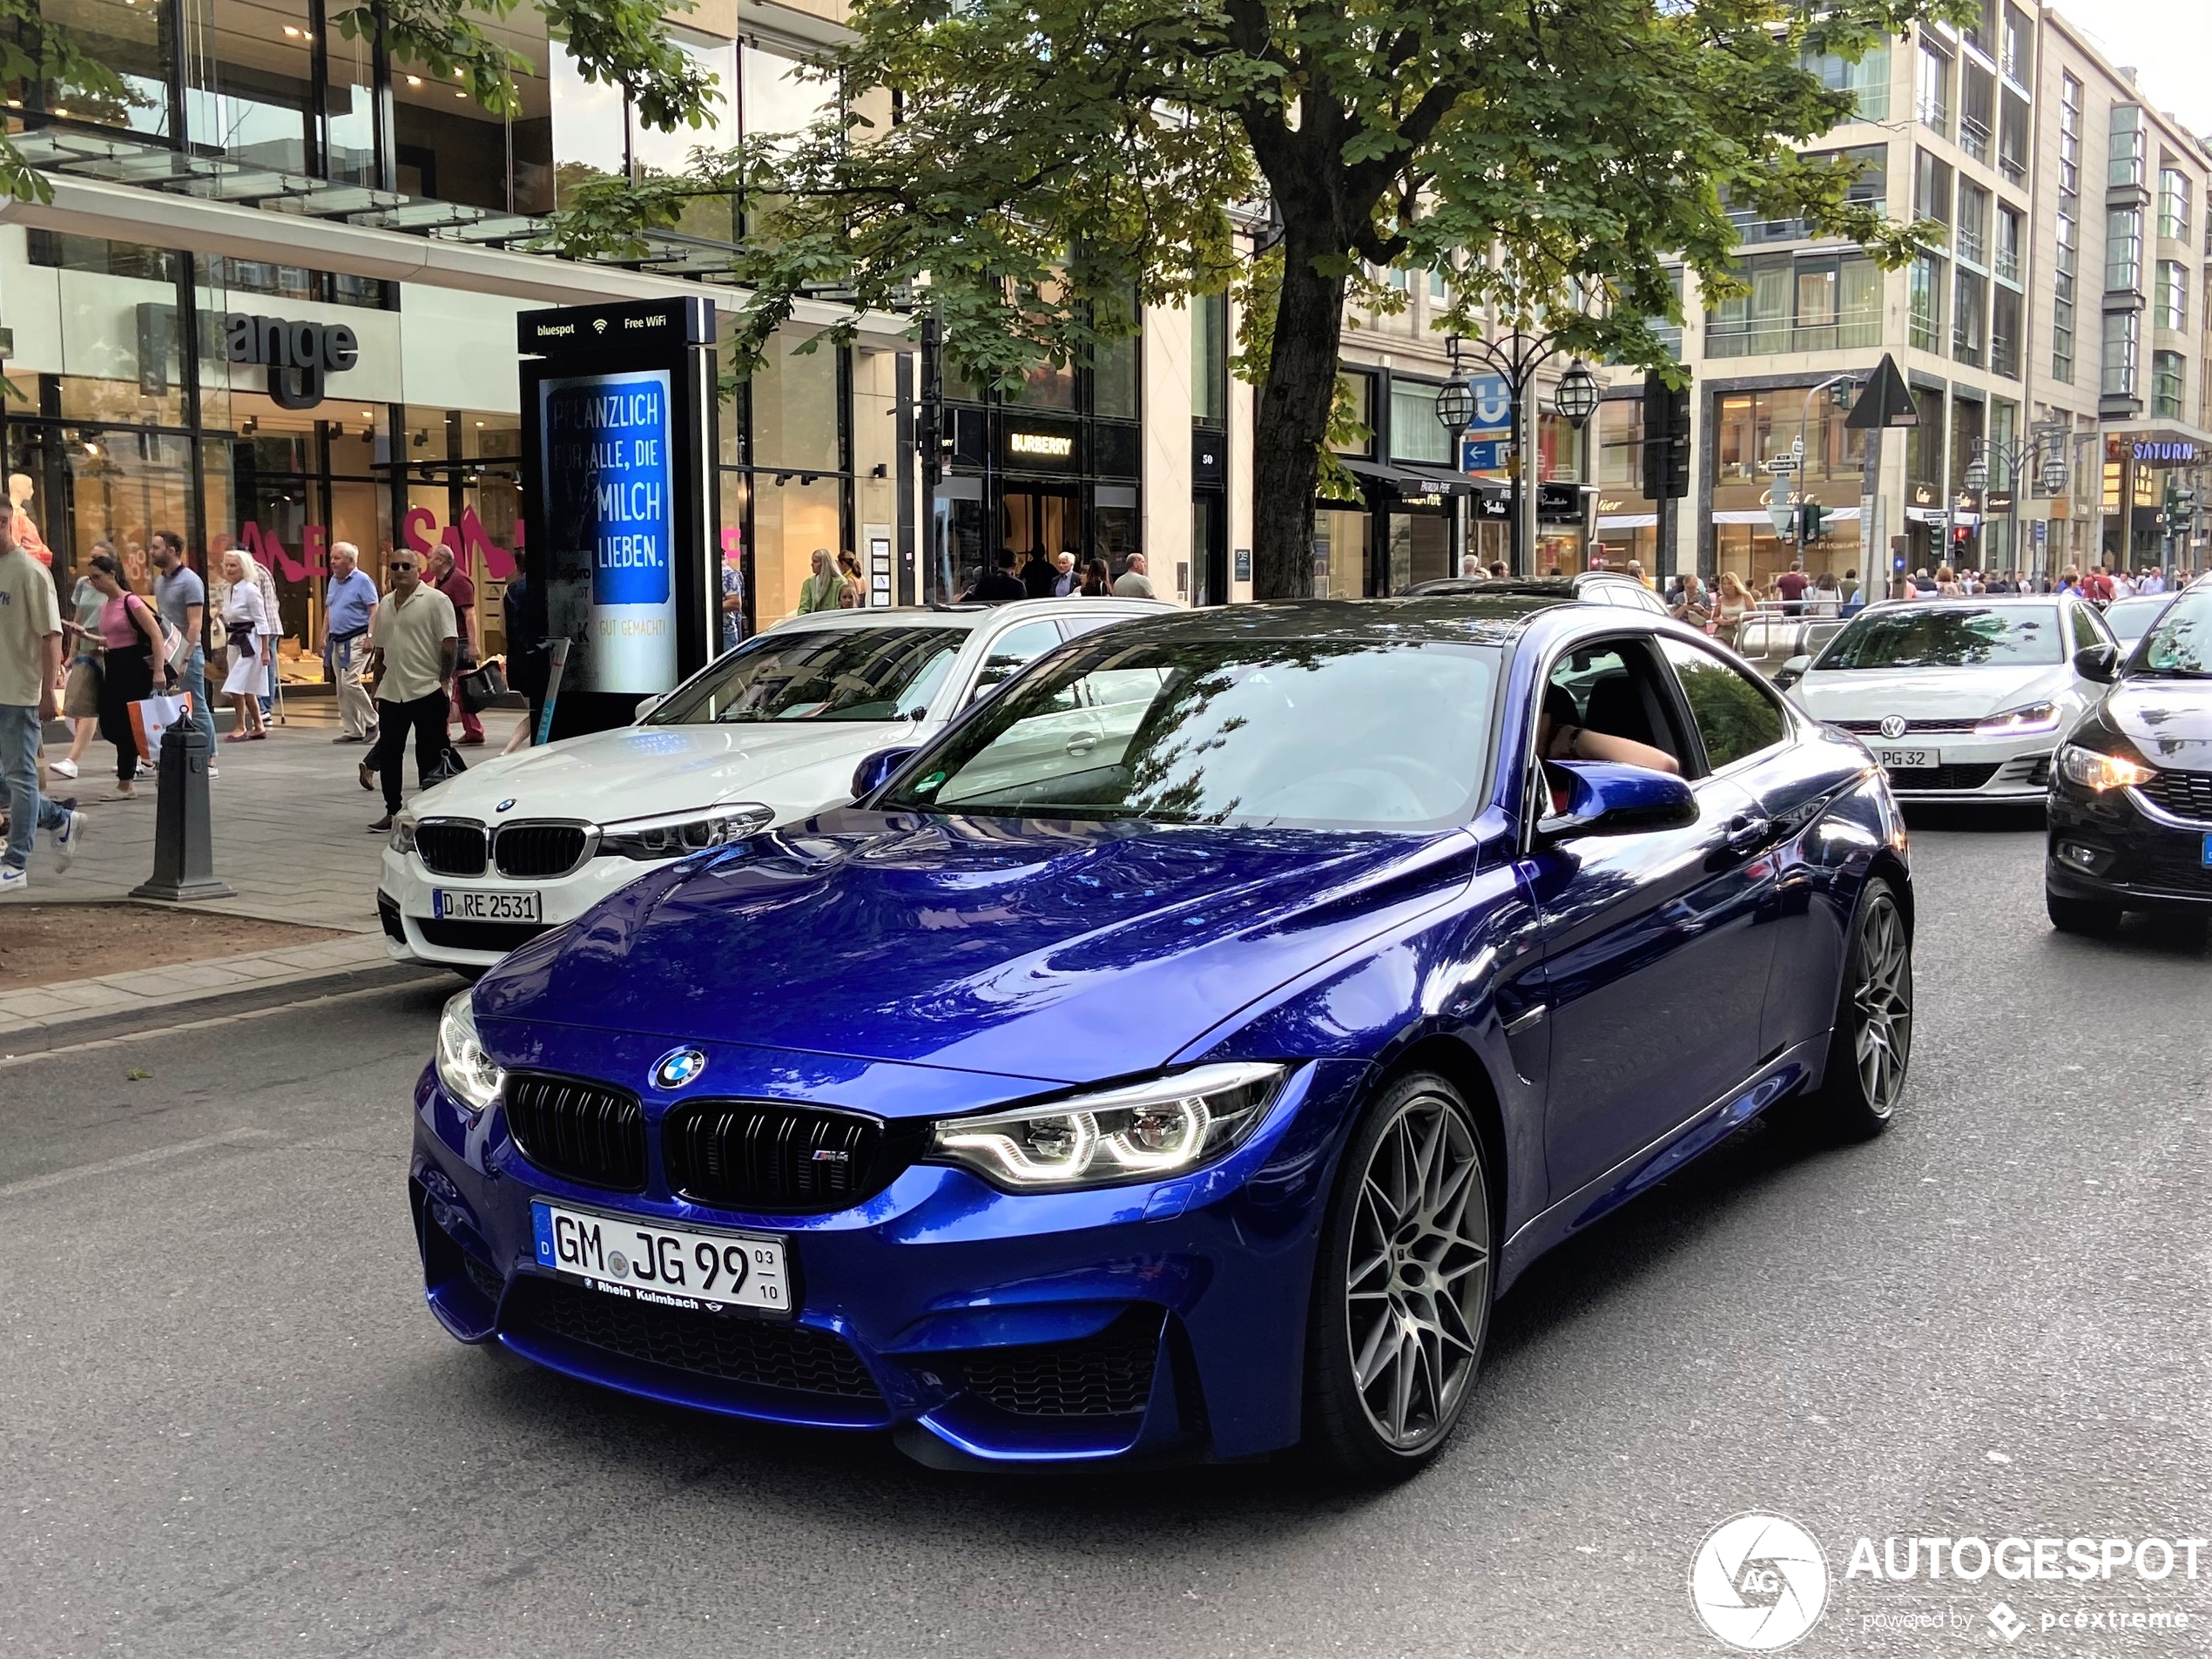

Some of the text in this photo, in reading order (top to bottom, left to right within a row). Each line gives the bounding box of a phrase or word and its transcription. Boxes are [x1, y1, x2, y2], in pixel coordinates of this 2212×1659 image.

[537, 323, 575, 337] bluespot
[624, 314, 667, 329] Free WiFi
[1010, 433, 1072, 455] BURBERRY
[2134, 442, 2193, 460] SATURN
[590, 440, 630, 471] ALLE,
[635, 439, 658, 467] DIE
[1202, 454, 1213, 464] 50
[597, 482, 660, 522] MILCH
[598, 534, 664, 568] LIEBEN.
[599, 620, 617, 636] GUT
[621, 619, 665, 636] GEMACHT!
[1882, 751, 1925, 765] PG 32
[443, 893, 535, 919] D RE 2531
[541, 1240, 550, 1256] D
[555, 1216, 773, 1294] GM JG 99 03
[597, 1280, 699, 1310] Rhein Kulmbach
[759, 1283, 778, 1299] 10
